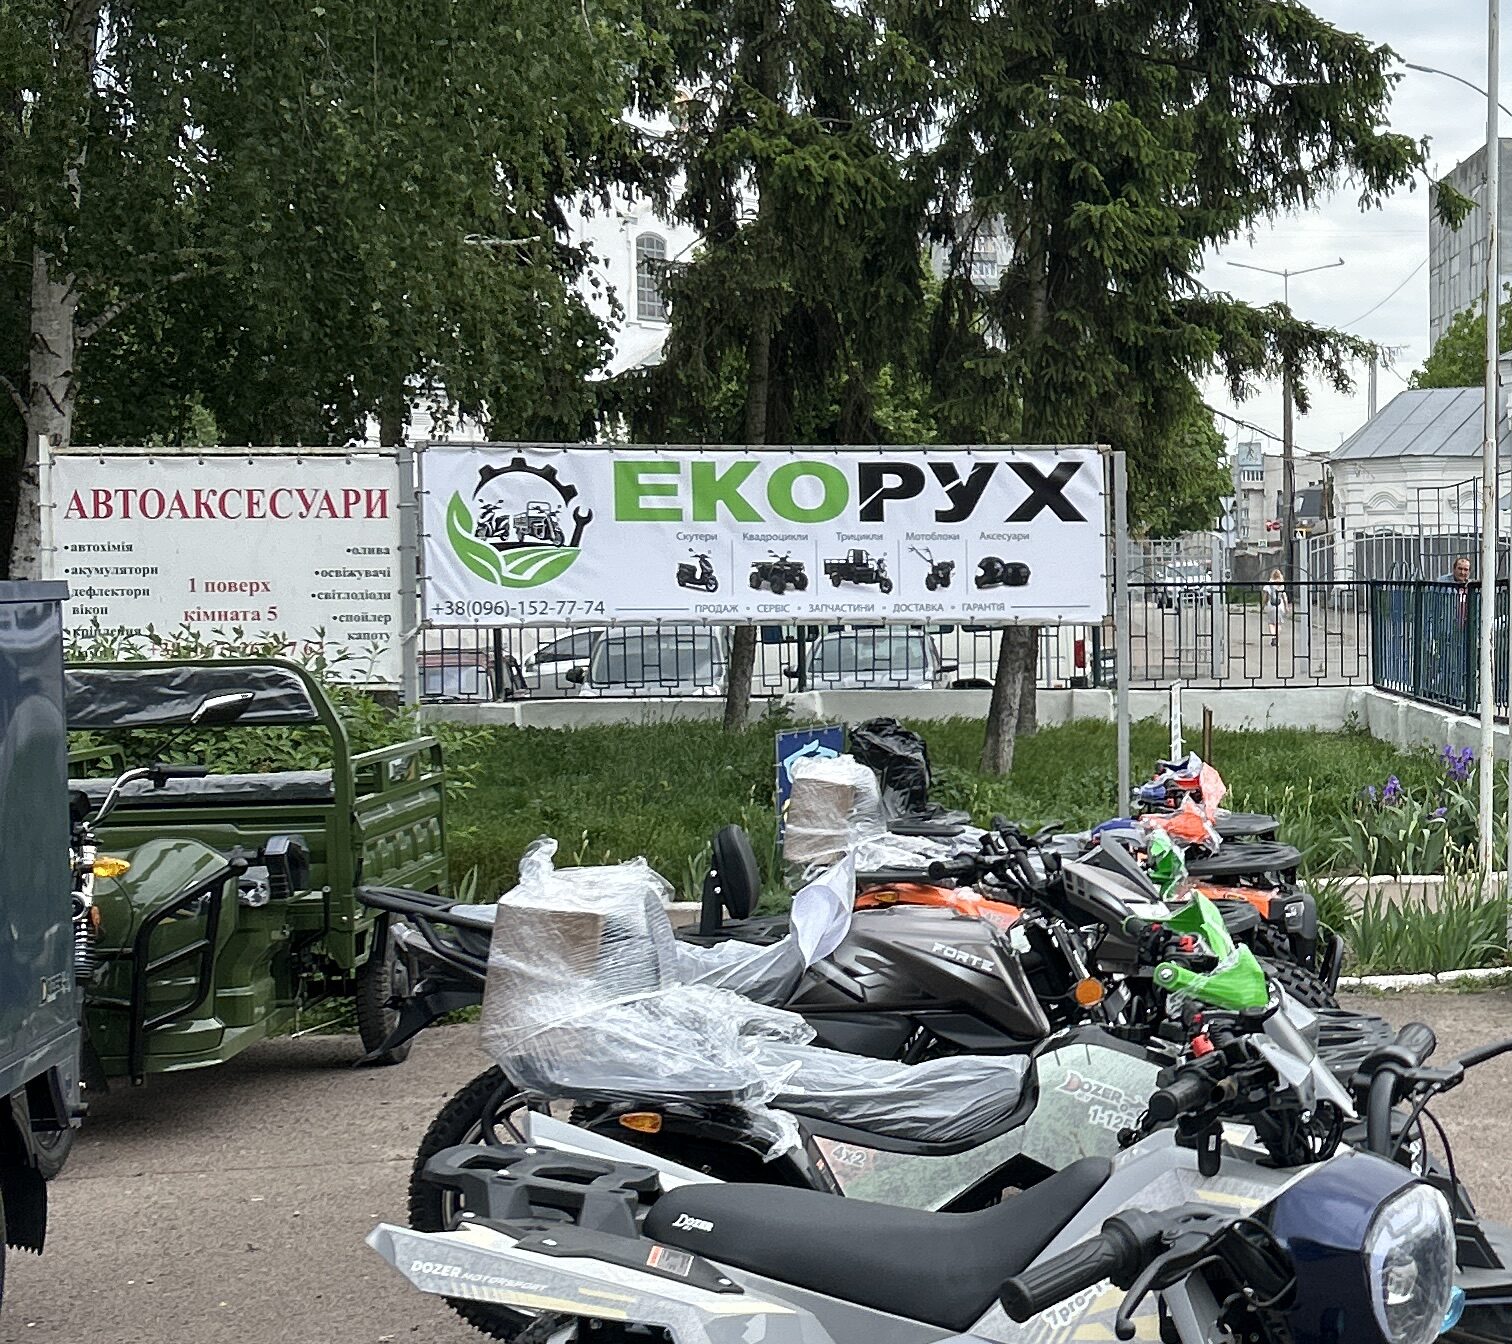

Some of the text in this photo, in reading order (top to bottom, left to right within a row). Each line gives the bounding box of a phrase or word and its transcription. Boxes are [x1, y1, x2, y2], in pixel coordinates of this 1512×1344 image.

[614, 459, 1088, 524] ЕКОРУХ
[64, 487, 390, 520] АВТОАКСЕСУАРИ
[676, 531, 718, 542] Скутери
[742, 532, 809, 542] Квадроцикли
[836, 531, 884, 542] Трицикли
[905, 531, 960, 541] Мотоблоки
[979, 531, 1030, 542] Аксесуари
[71, 541, 133, 552] автохімія
[352, 546, 390, 555] олива
[71, 566, 158, 578] акумулятори
[320, 567, 391, 580] освіжувачі
[71, 586, 150, 599] дефлектори
[188, 578, 271, 596] 1 поверх
[72, 604, 109, 615] вікон
[183, 606, 278, 622] кімната 5
[432, 600, 606, 617] +38(096)-152-77-74
[695, 602, 1005, 614] ПРОДАЖ СЕРВІС ЗАПЧАСТИНИ ДОСТАВКА ГАРАНТІЯ
[339, 612, 392, 625] спойлер
[347, 631, 392, 643] капоту
[932, 942, 995, 972] FORTE
[1058, 1070, 1124, 1104] DOZER
[410, 1260, 462, 1277] DOZER
